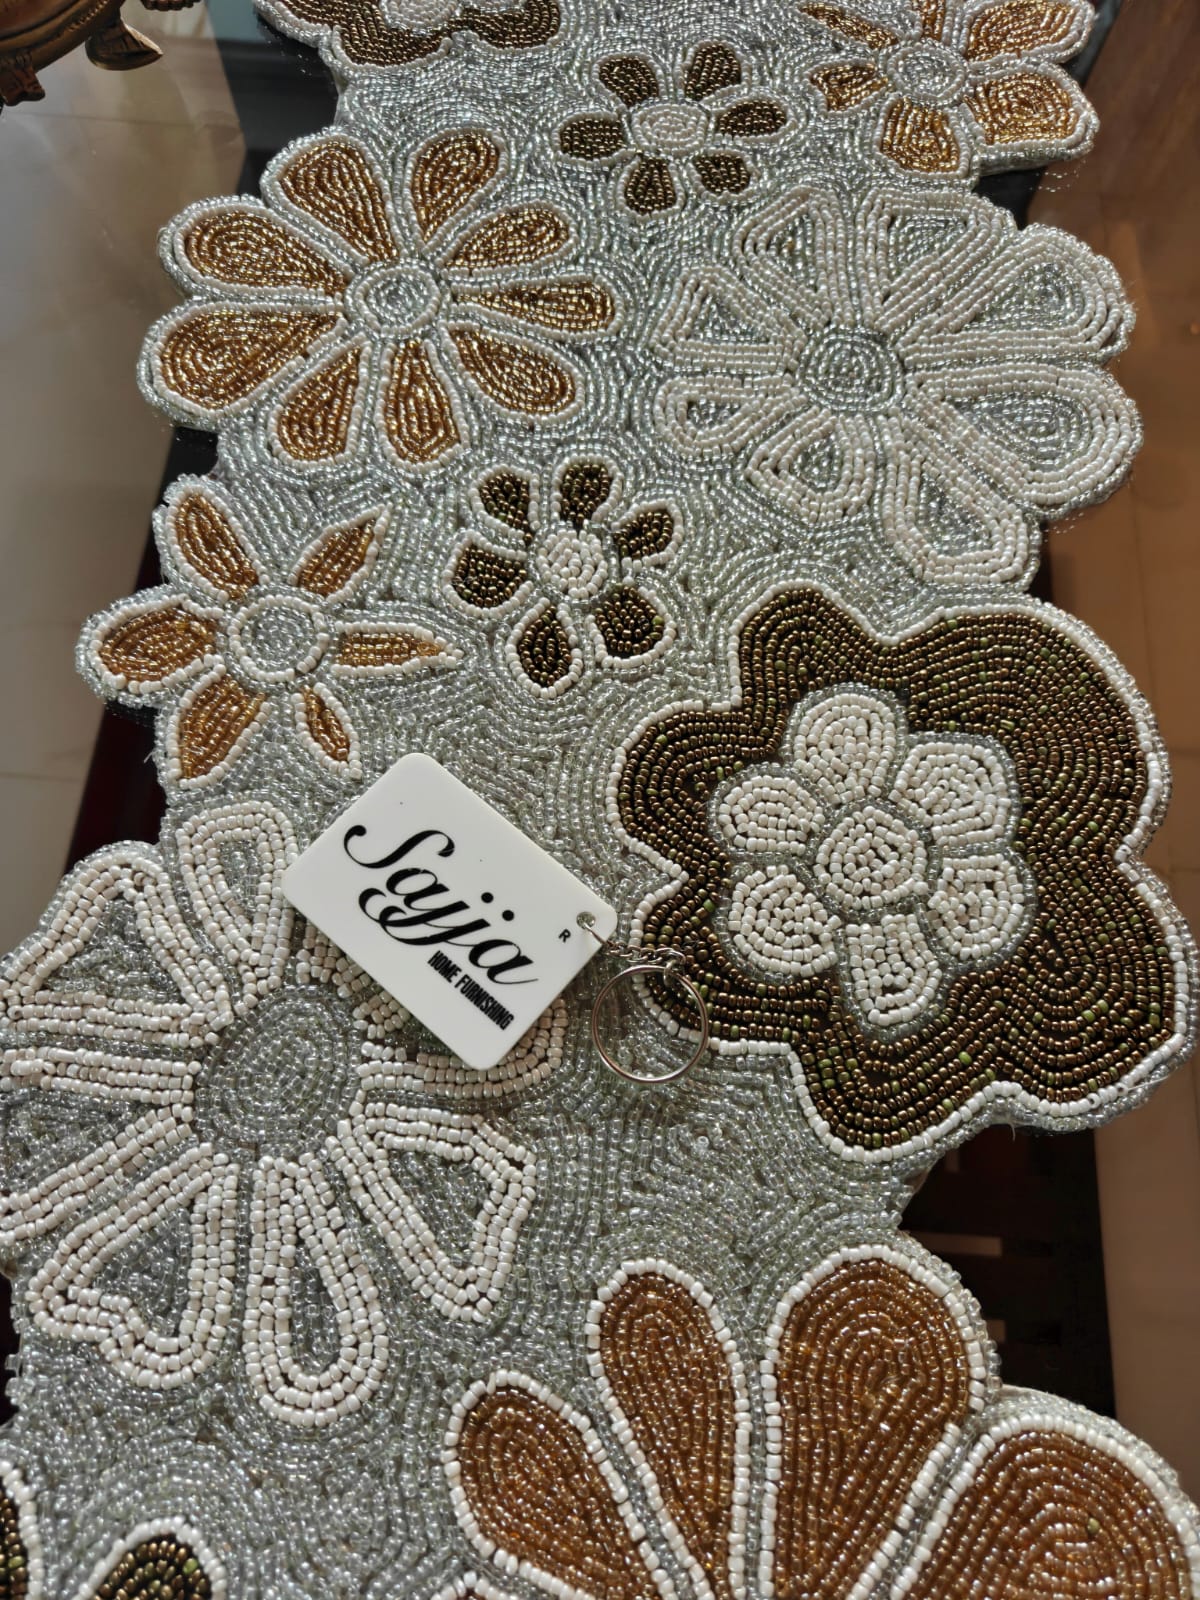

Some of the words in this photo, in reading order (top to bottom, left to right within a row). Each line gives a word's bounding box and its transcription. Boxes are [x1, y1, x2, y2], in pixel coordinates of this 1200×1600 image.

[344, 824, 539, 985] Sajja
[558, 928, 572, 943] R
[427, 950, 462, 983] HOME
[454, 974, 515, 1031] FURNISHING
